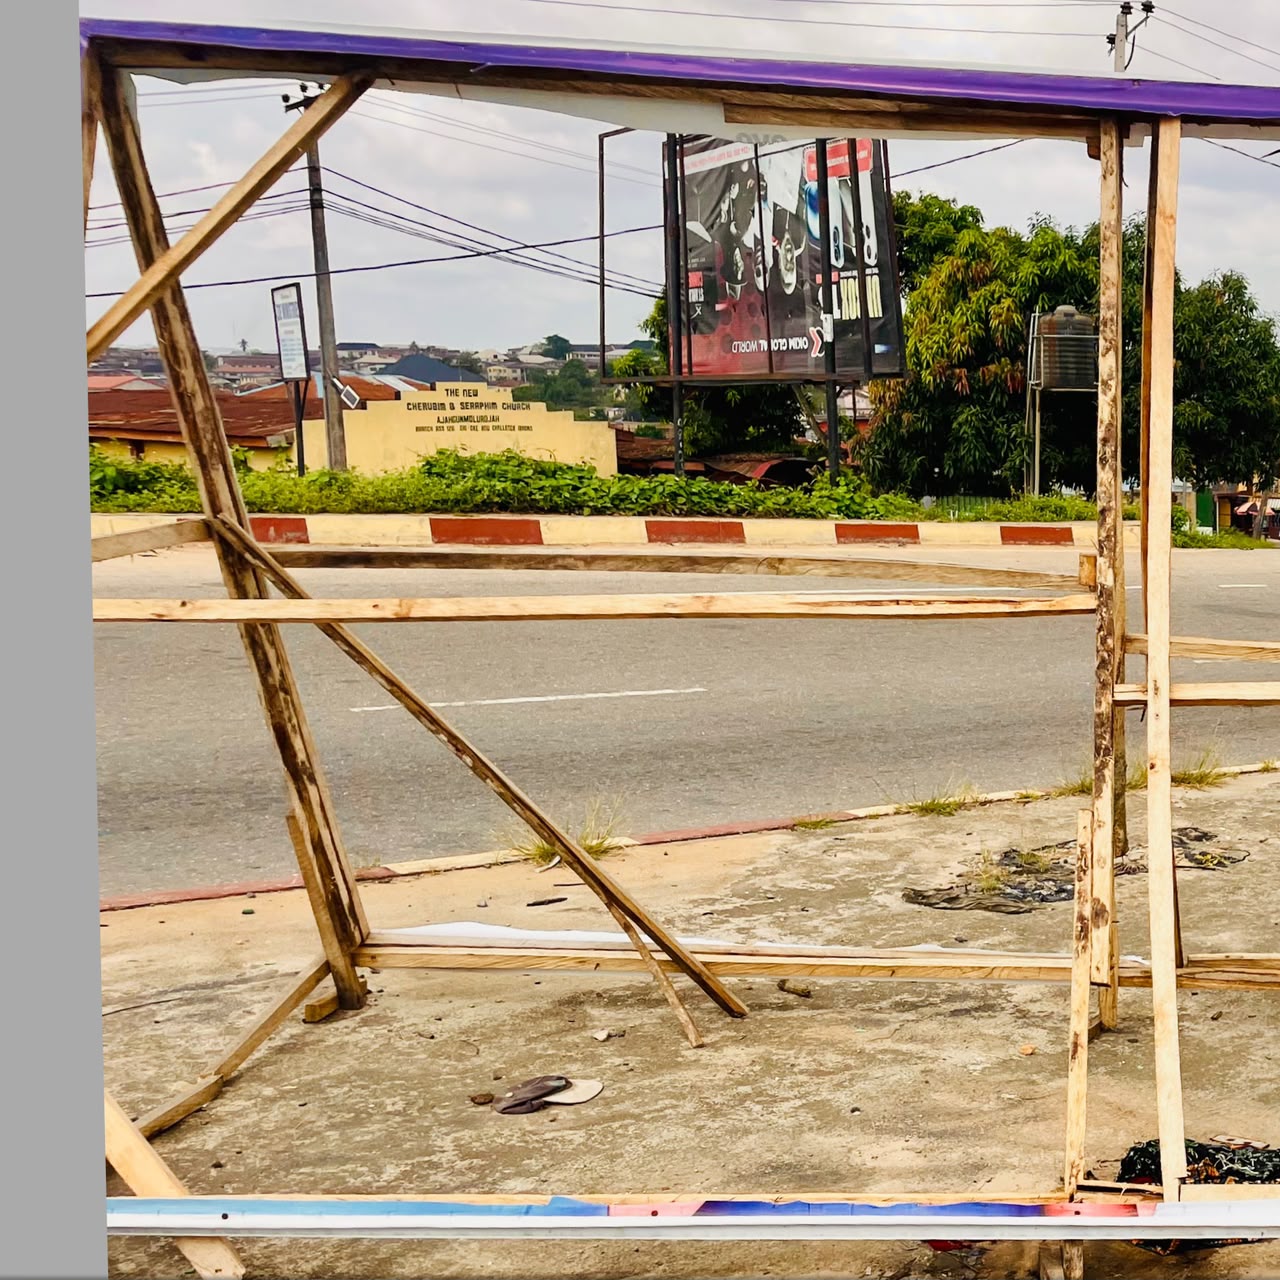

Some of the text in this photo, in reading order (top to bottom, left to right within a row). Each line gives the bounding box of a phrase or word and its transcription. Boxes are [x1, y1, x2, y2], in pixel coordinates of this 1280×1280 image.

[732, 337, 808, 353] OKIM GLOAL WORLD
[445, 389, 478, 397] THE NEW
[406, 402, 446, 411] CHERUBIM
[460, 402, 498, 410] SERAPHIM
[502, 402, 531, 411] CHURCH
